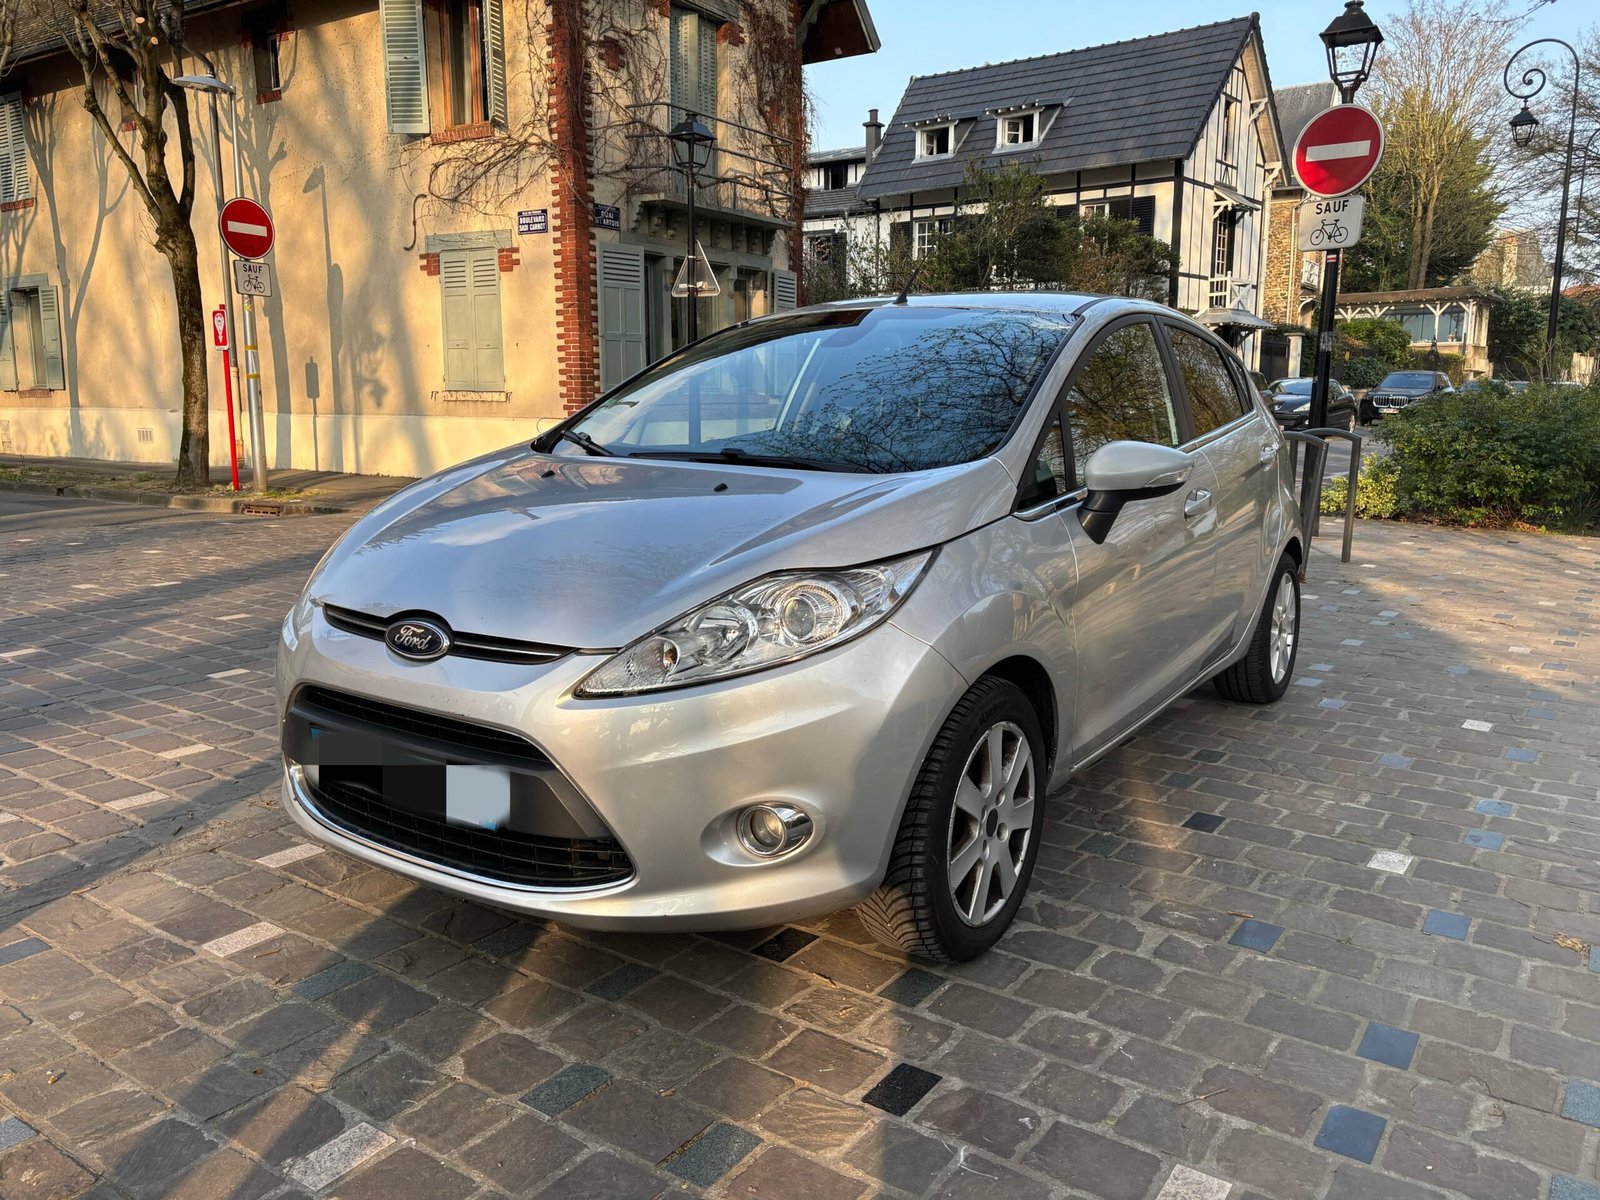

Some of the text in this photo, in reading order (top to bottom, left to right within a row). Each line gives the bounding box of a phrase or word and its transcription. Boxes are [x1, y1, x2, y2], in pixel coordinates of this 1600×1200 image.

[1315, 200, 1349, 215] SAUF
[519, 215, 545, 225] BOULEVARD
[242, 263, 262, 274] SAUF
[394, 624, 432, 650] Ford
